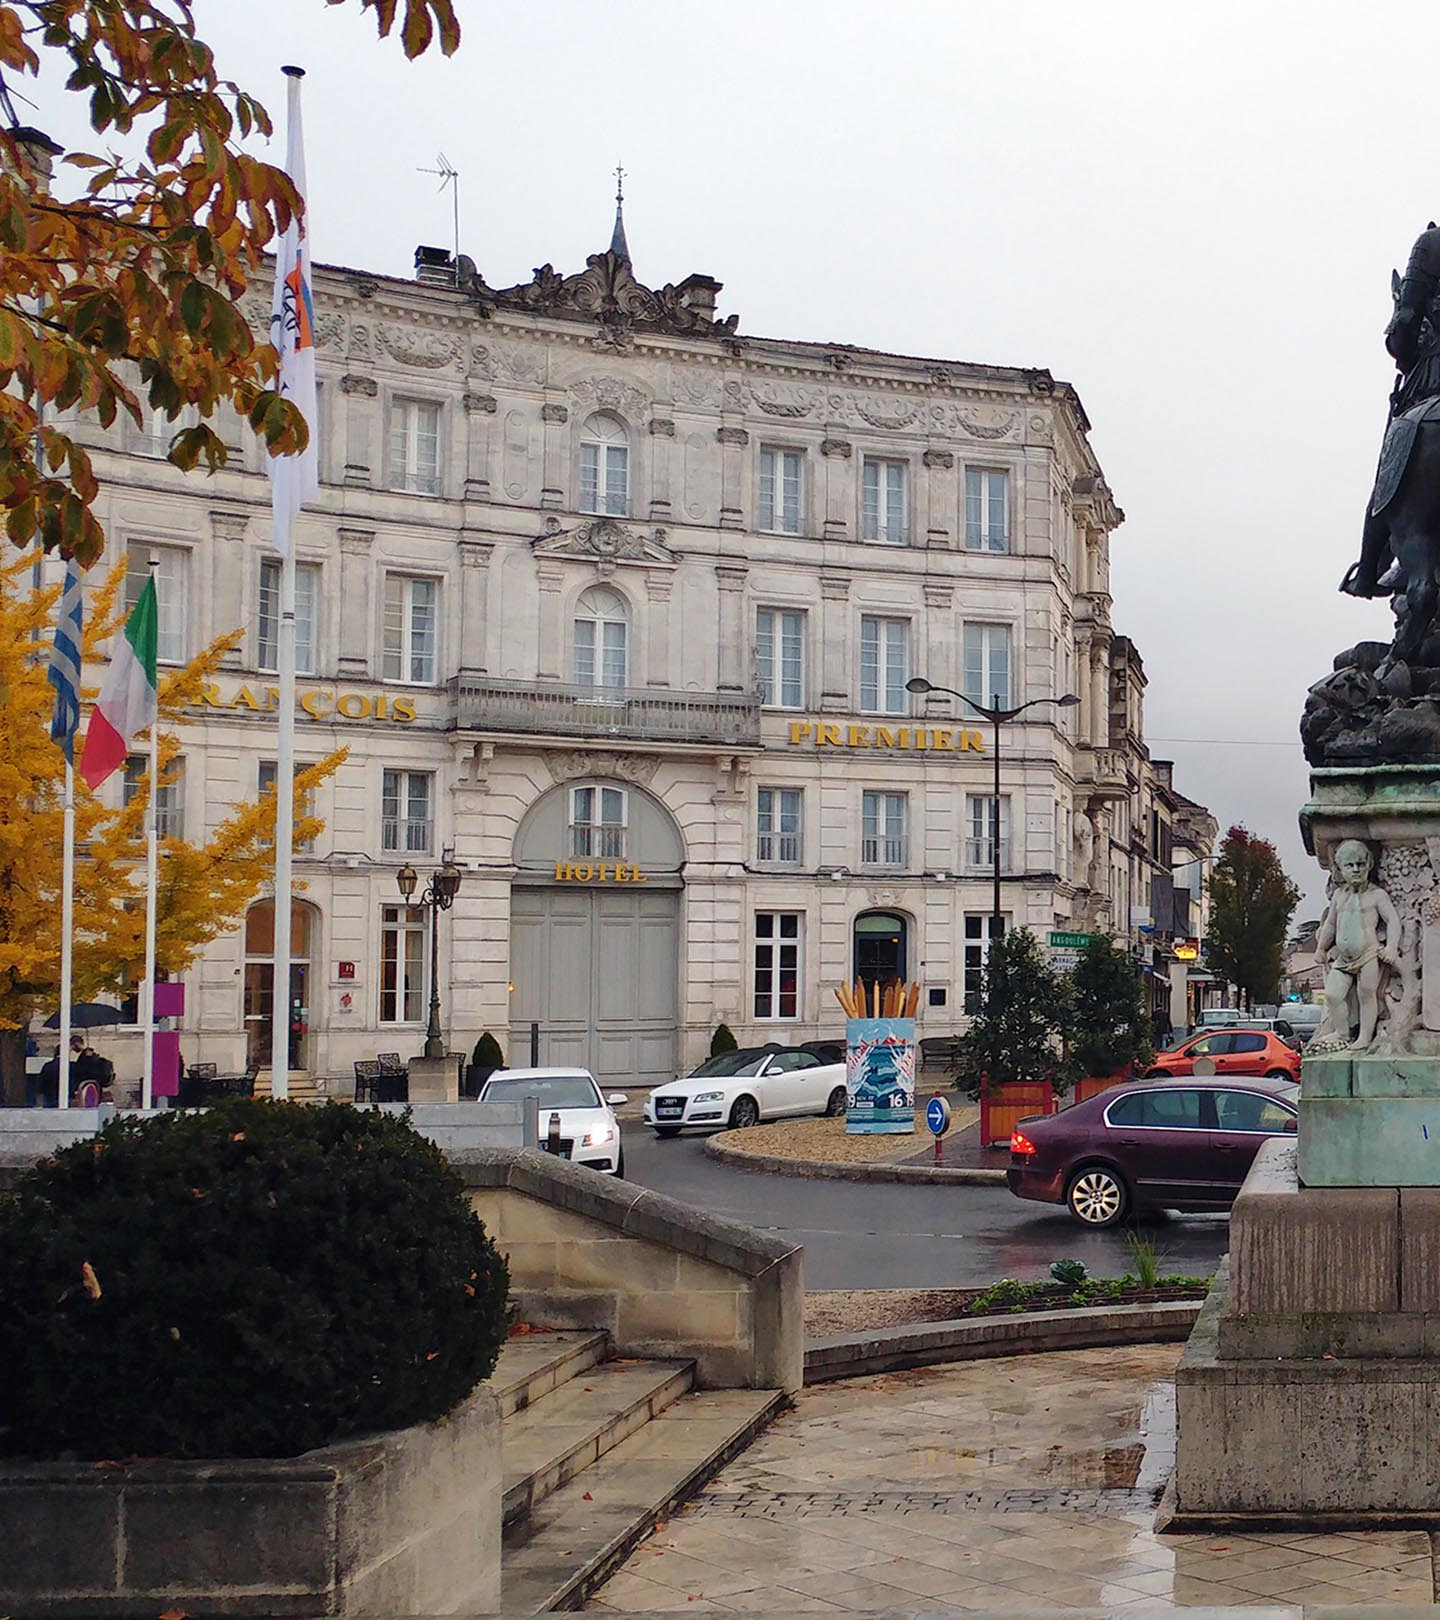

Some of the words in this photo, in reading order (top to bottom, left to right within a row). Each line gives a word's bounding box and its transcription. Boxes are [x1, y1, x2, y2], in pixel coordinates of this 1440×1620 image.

[788, 721, 986, 752] PREMIER
[554, 863, 648, 882] HOTEL
[888, 1093, 903, 1108] 16
